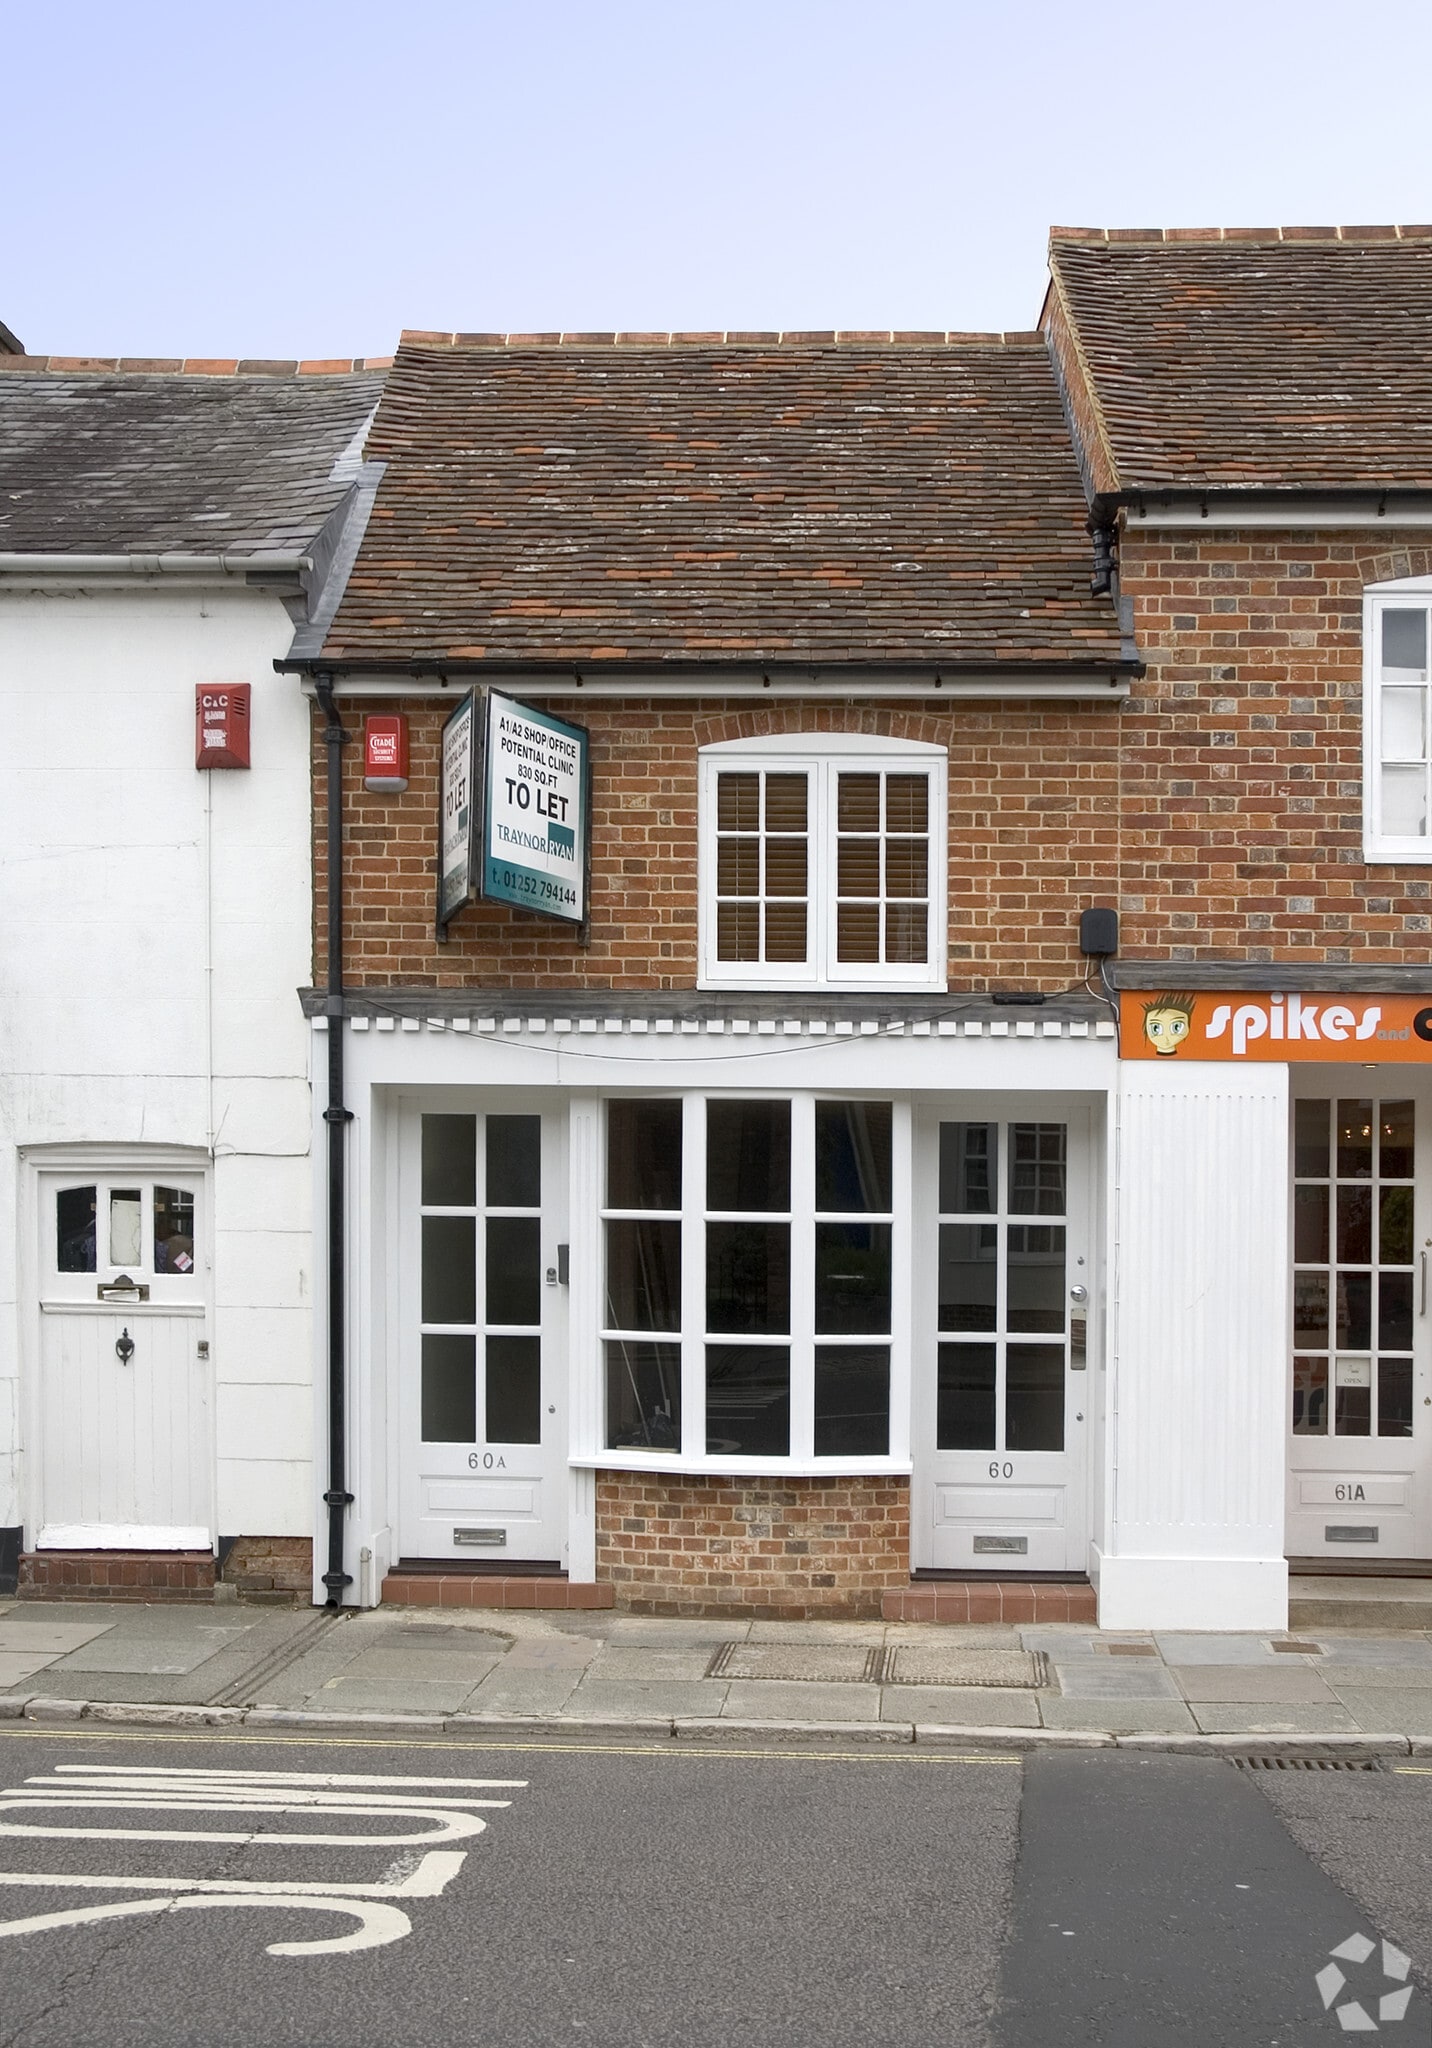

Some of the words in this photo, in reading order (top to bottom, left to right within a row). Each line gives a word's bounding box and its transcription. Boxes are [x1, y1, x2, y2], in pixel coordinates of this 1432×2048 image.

[499, 716, 522, 738] A1/A2
[523, 726, 576, 759] SHOP/OFFICE
[501, 736, 546, 766] POTENTIAL
[548, 755, 574, 776] CLINIC
[518, 763, 532, 780] 830
[534, 768, 558, 789] SQ.FT
[505, 777, 530, 810] TO
[537, 788, 569, 822] LET
[497, 823, 547, 853] TRAYNOR
[548, 839, 575, 861] RYAN
[503, 870, 537, 895] 01252
[540, 880, 577, 906] 794144
[1205, 991, 1382, 1055] spikes
[1376, 1025, 1411, 1041] and
[468, 1452, 507, 1470] 60A
[989, 1461, 1014, 1479] 60
[1334, 1484, 1366, 1501] 61A
